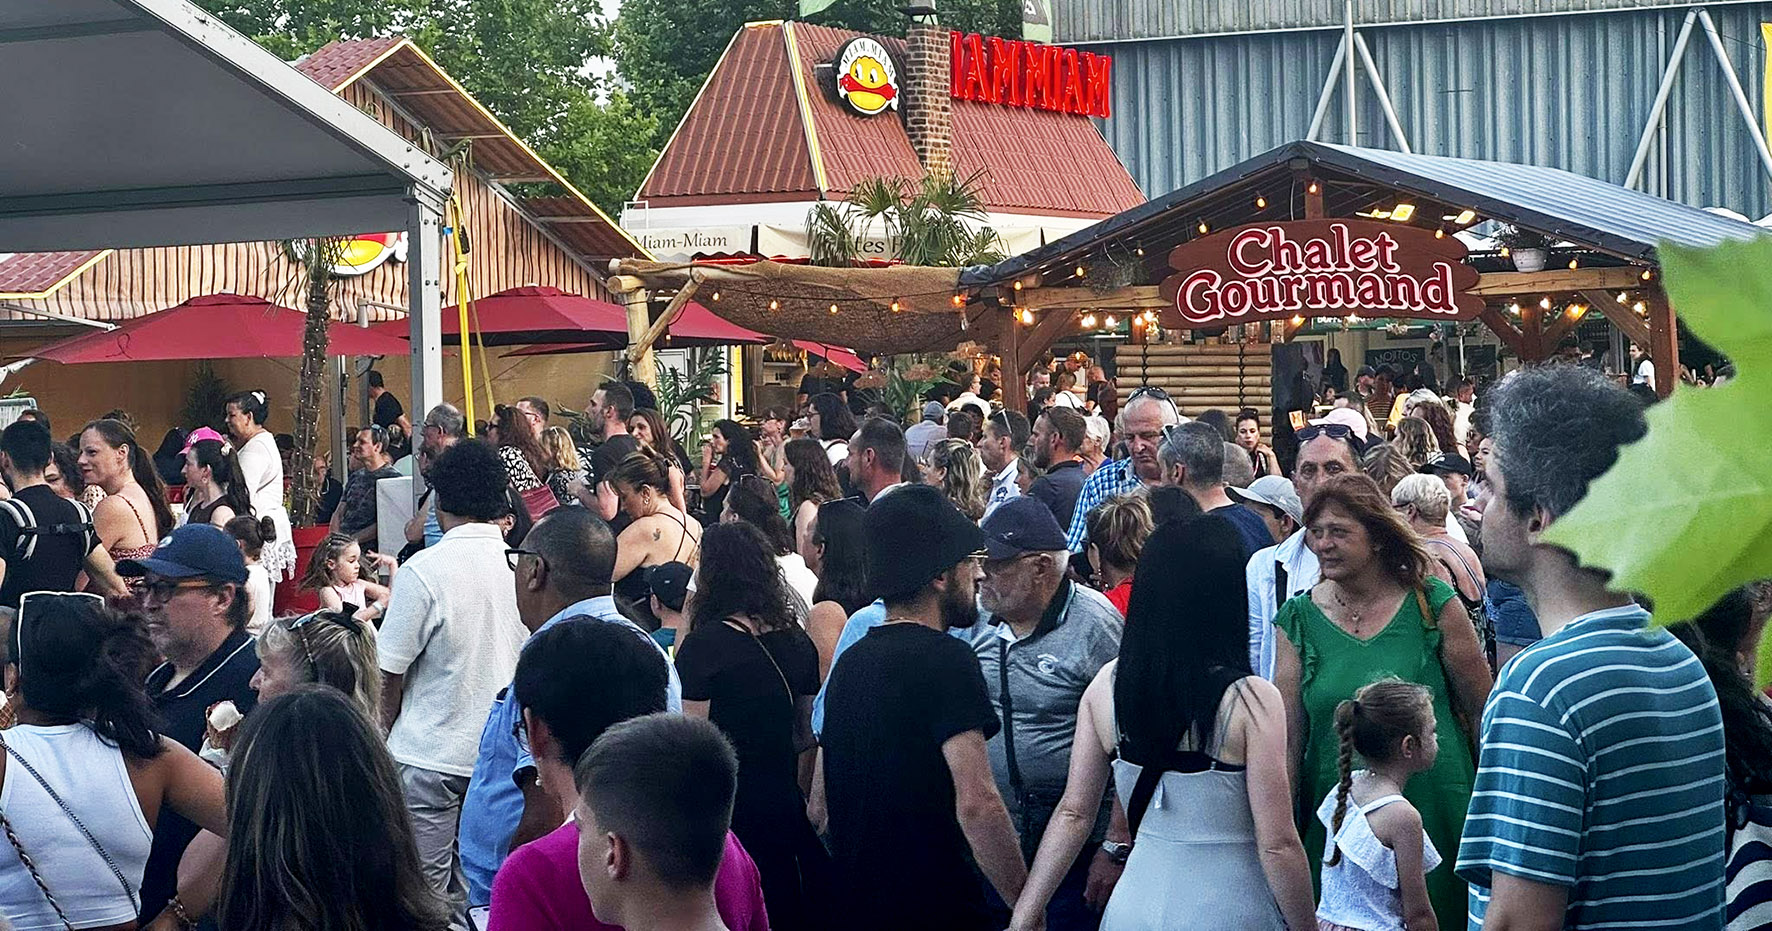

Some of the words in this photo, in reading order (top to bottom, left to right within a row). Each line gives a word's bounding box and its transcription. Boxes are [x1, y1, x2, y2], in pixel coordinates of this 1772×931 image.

[950, 31, 1111, 118] IAMMIAM
[634, 232, 727, 249] Miam-Miam
[1227, 224, 1399, 277] Chalet
[1176, 262, 1459, 322] Gourmand
